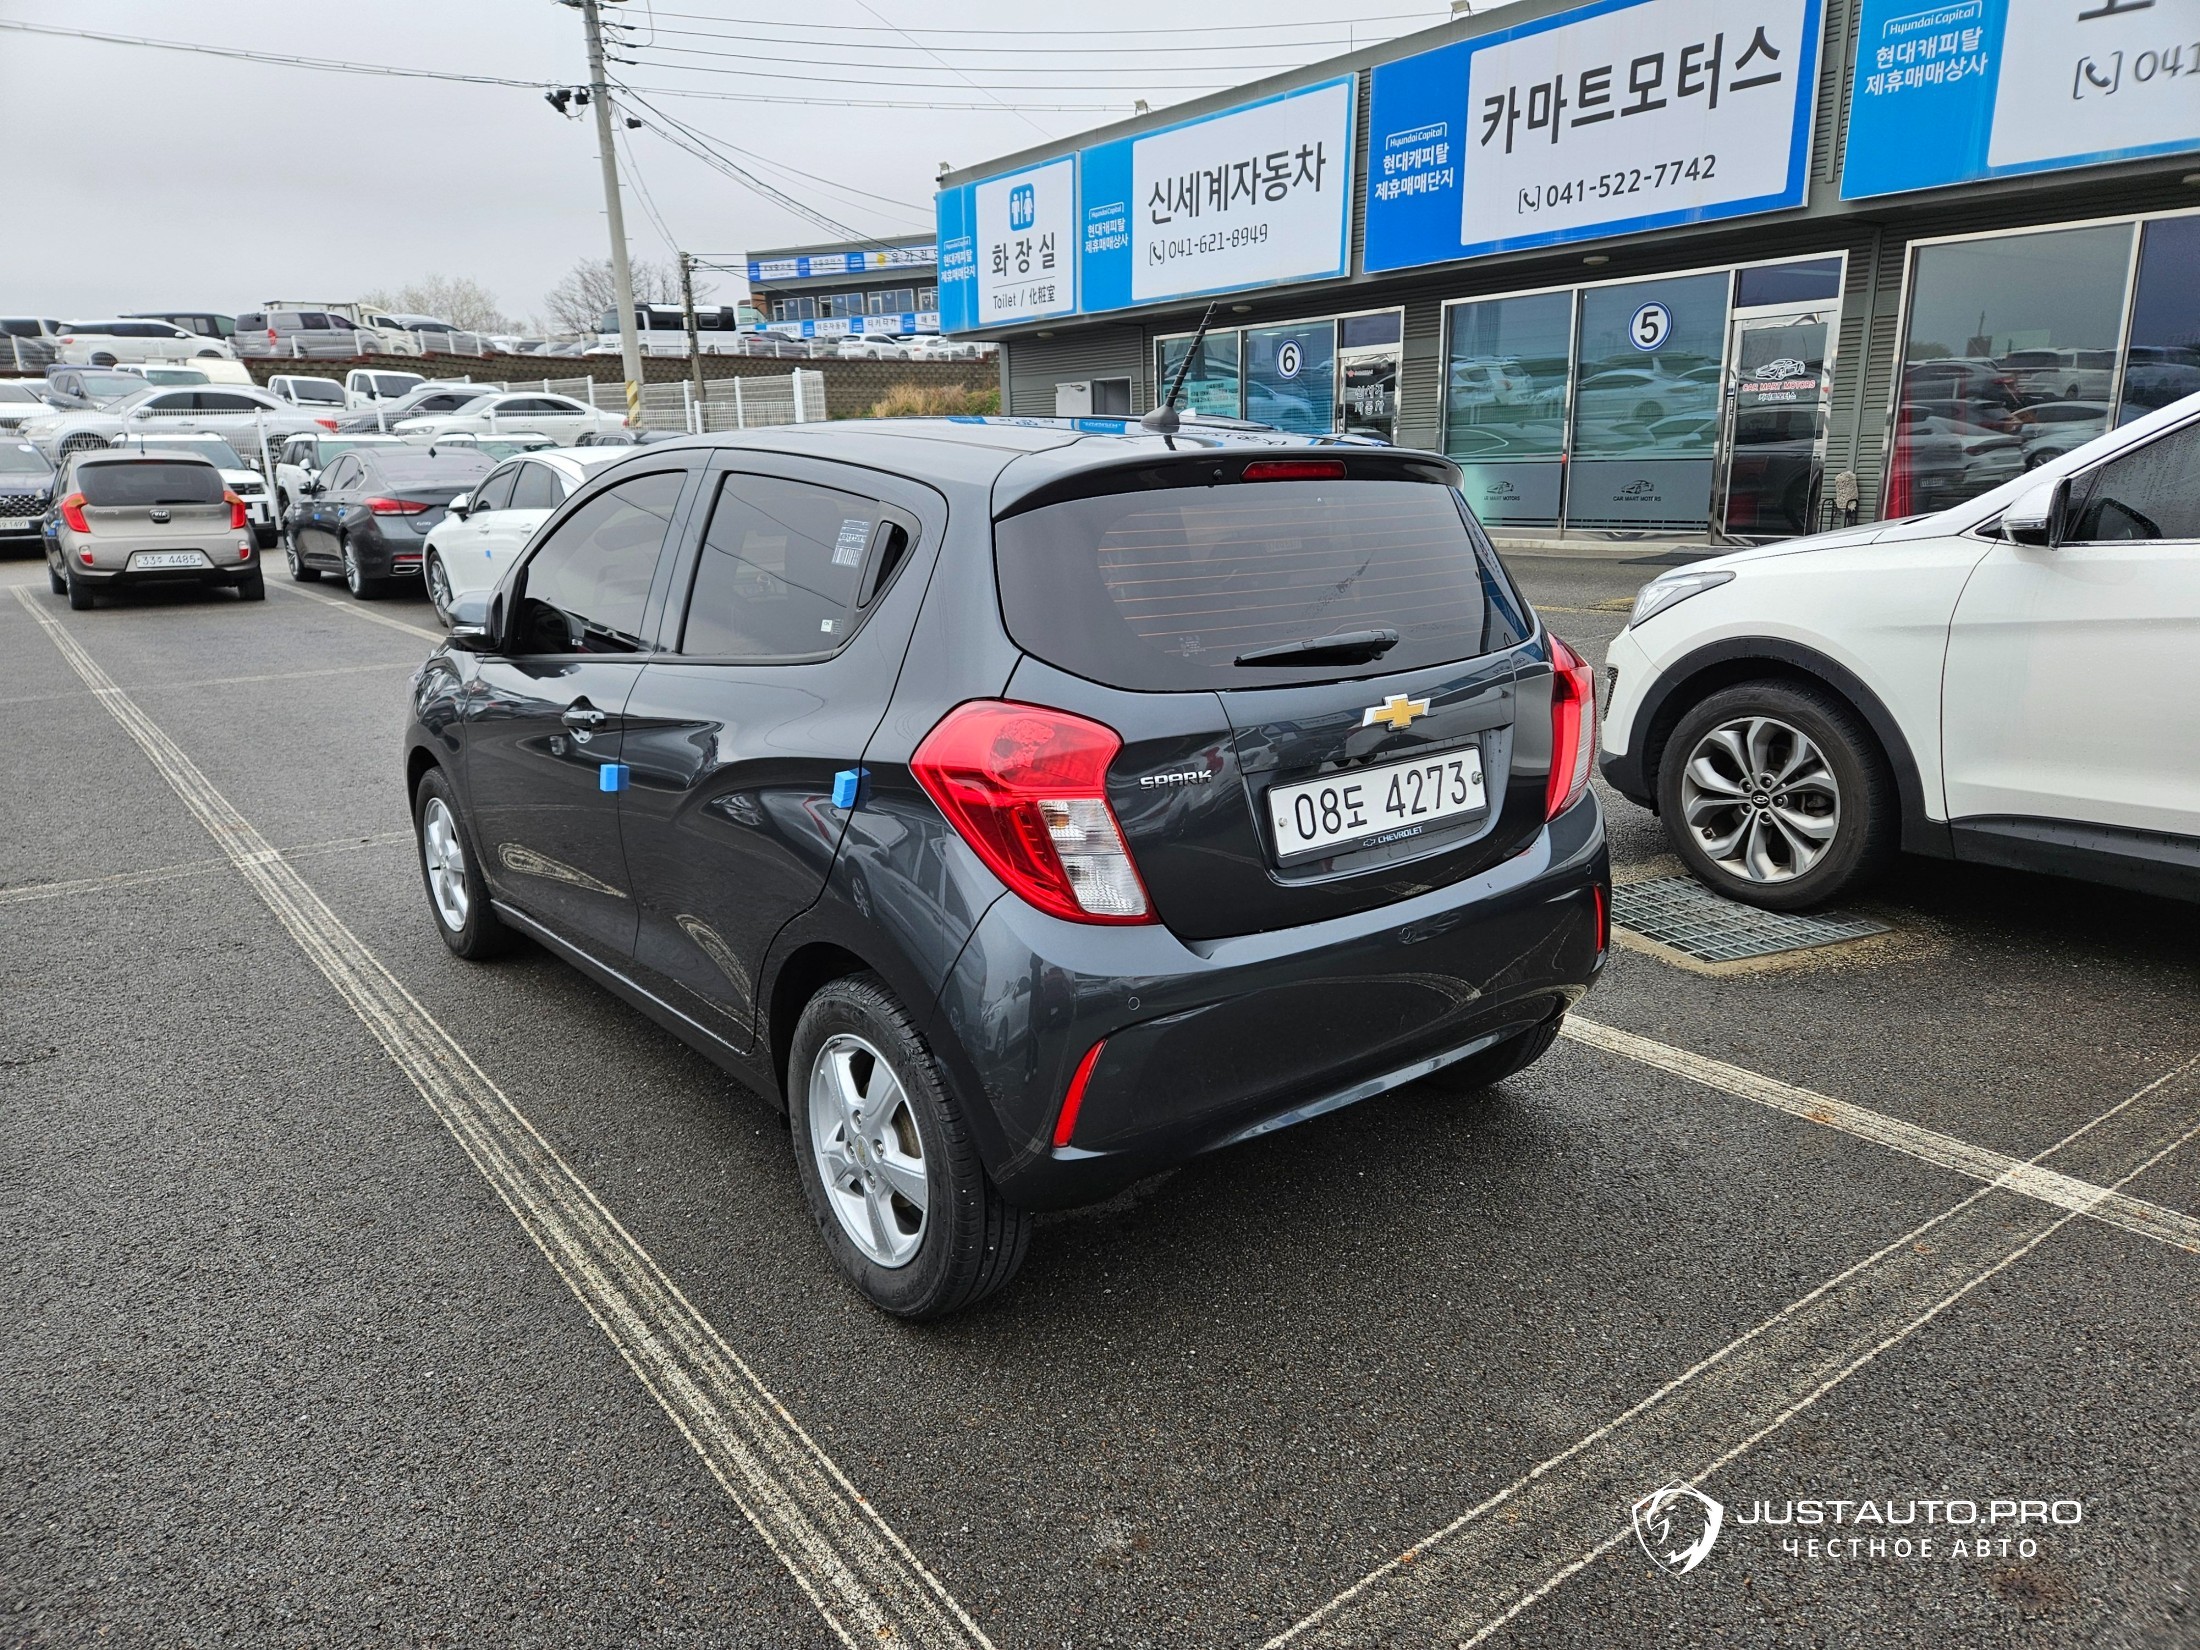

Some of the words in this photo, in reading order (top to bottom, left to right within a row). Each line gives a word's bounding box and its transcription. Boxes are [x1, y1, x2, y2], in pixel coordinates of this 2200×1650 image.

[1890, 15, 1935, 35] Hyundai
[1935, 6, 1975, 25] Capital
[1877, 26, 1983, 69] 현대캐피탈
[1864, 52, 1989, 96] 제휴매매상사
[1480, 26, 1782, 154] 카마트모터스
[1390, 133, 1418, 148] Hyundai
[1418, 127, 1443, 141] Capital
[1383, 142, 1450, 175] 현대캐피탈
[1148, 141, 1326, 226] 신세계자동차
[1375, 167, 1454, 200] 제휴매매단지
[1545, 154, 1717, 208] 041-522-7742
[1087, 217, 1125, 238] 현대캐피탈
[1168, 223, 1269, 260] 041-621-8949
[992, 232, 1055, 276] 화장실
[1085, 233, 1129, 253] 제휴매매상사
[943, 249, 972, 267] 현대캐피탈
[941, 264, 975, 283] 제휴매매단지
[993, 293, 1016, 309] Toilet
[1639, 310, 1659, 343] 5
[1283, 346, 1296, 372] 6
[1784, 380, 1816, 390] MOTORS
[168, 555, 196, 564] 4485
[1139, 769, 1213, 791] SPARK
[1294, 785, 1368, 841] 08도
[1385, 761, 1469, 818] 4273
[1377, 826, 1423, 843] CHEVROLET
